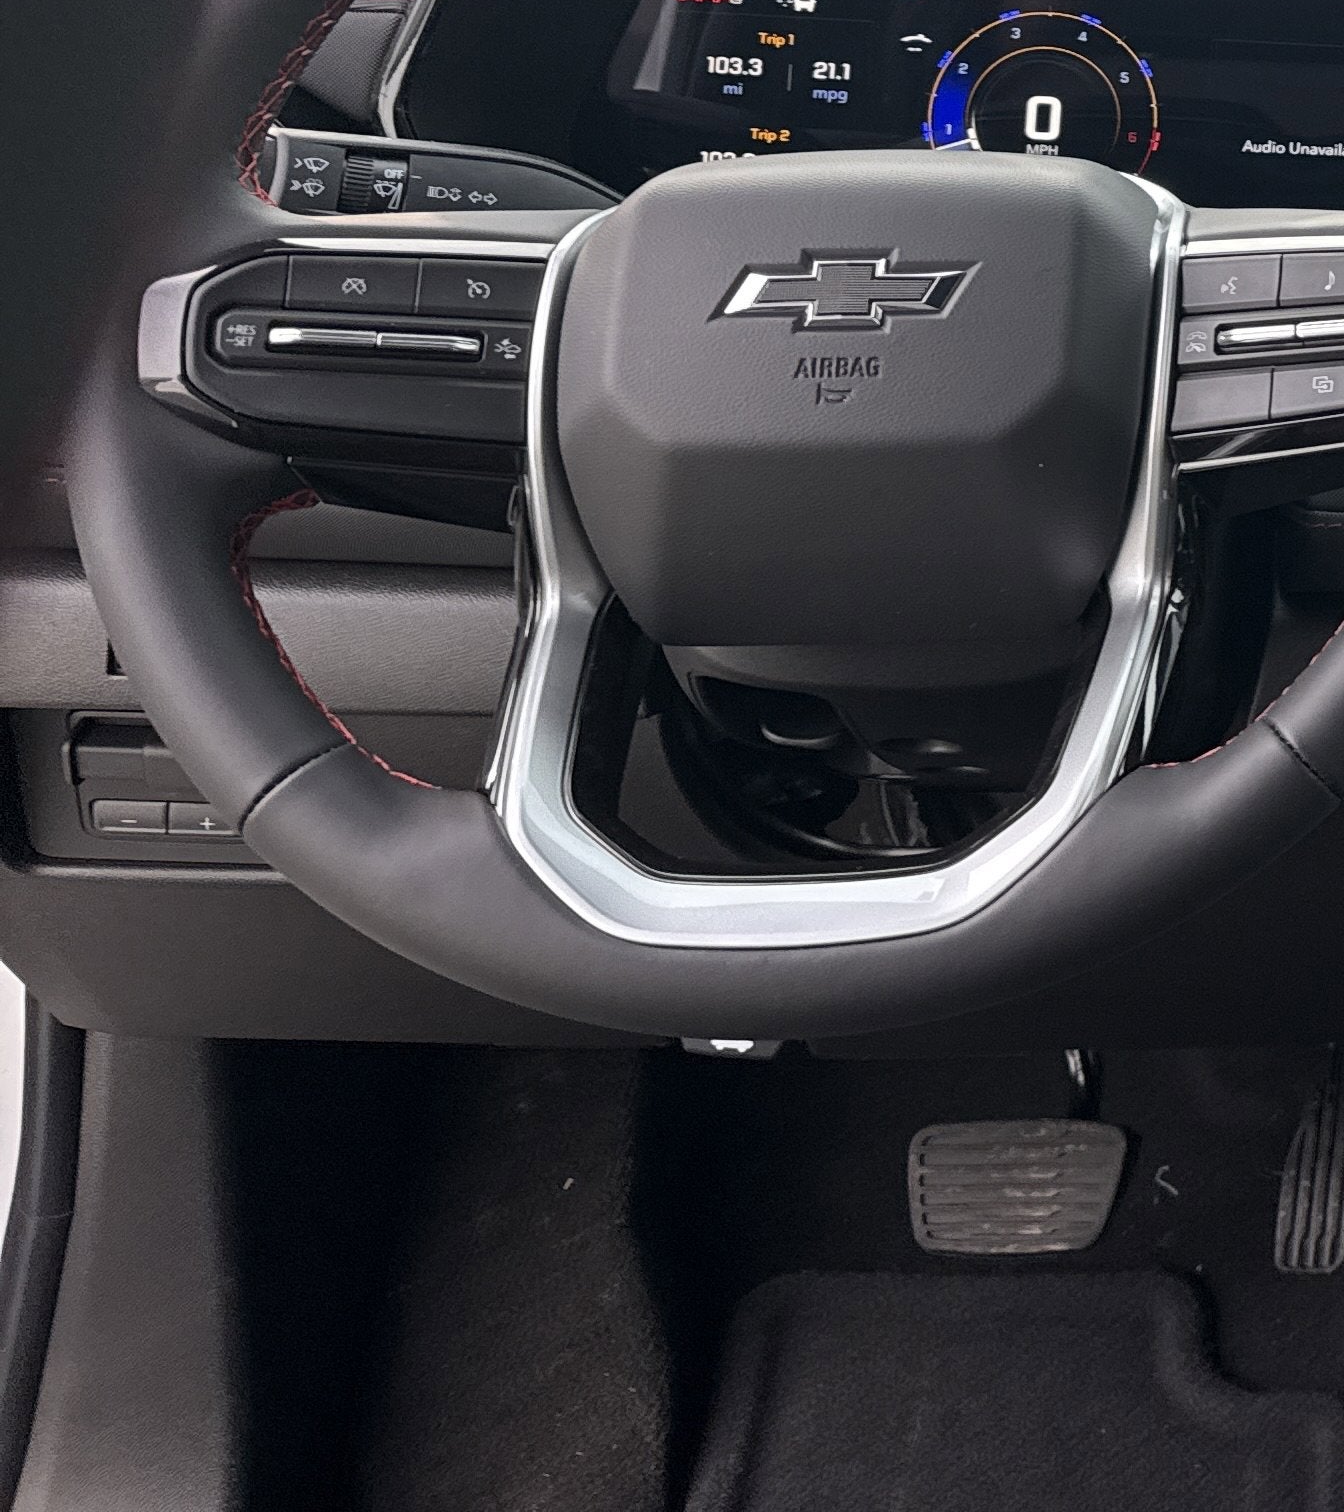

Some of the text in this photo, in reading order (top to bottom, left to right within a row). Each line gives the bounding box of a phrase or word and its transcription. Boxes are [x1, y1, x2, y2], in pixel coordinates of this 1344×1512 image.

[757, 31, 795, 48] Trip 1
[1010, 28, 1021, 39] 3
[1077, 31, 1088, 42] 4
[706, 55, 763, 76] 103.3
[812, 61, 851, 80] 21.1
[958, 63, 969, 75] 2
[1119, 71, 1130, 84] 5
[722, 82, 744, 96] mi
[812, 88, 849, 104] mpg
[1024, 95, 1062, 141] 0
[750, 127, 791, 143] Trip 2
[945, 123, 953, 135] 1
[1126, 131, 1137, 144] 6
[1025, 143, 1060, 155] MPH
[1241, 139, 1287, 154] Audio
[383, 168, 405, 180] OFF
[792, 356, 881, 379] AIRBAG
